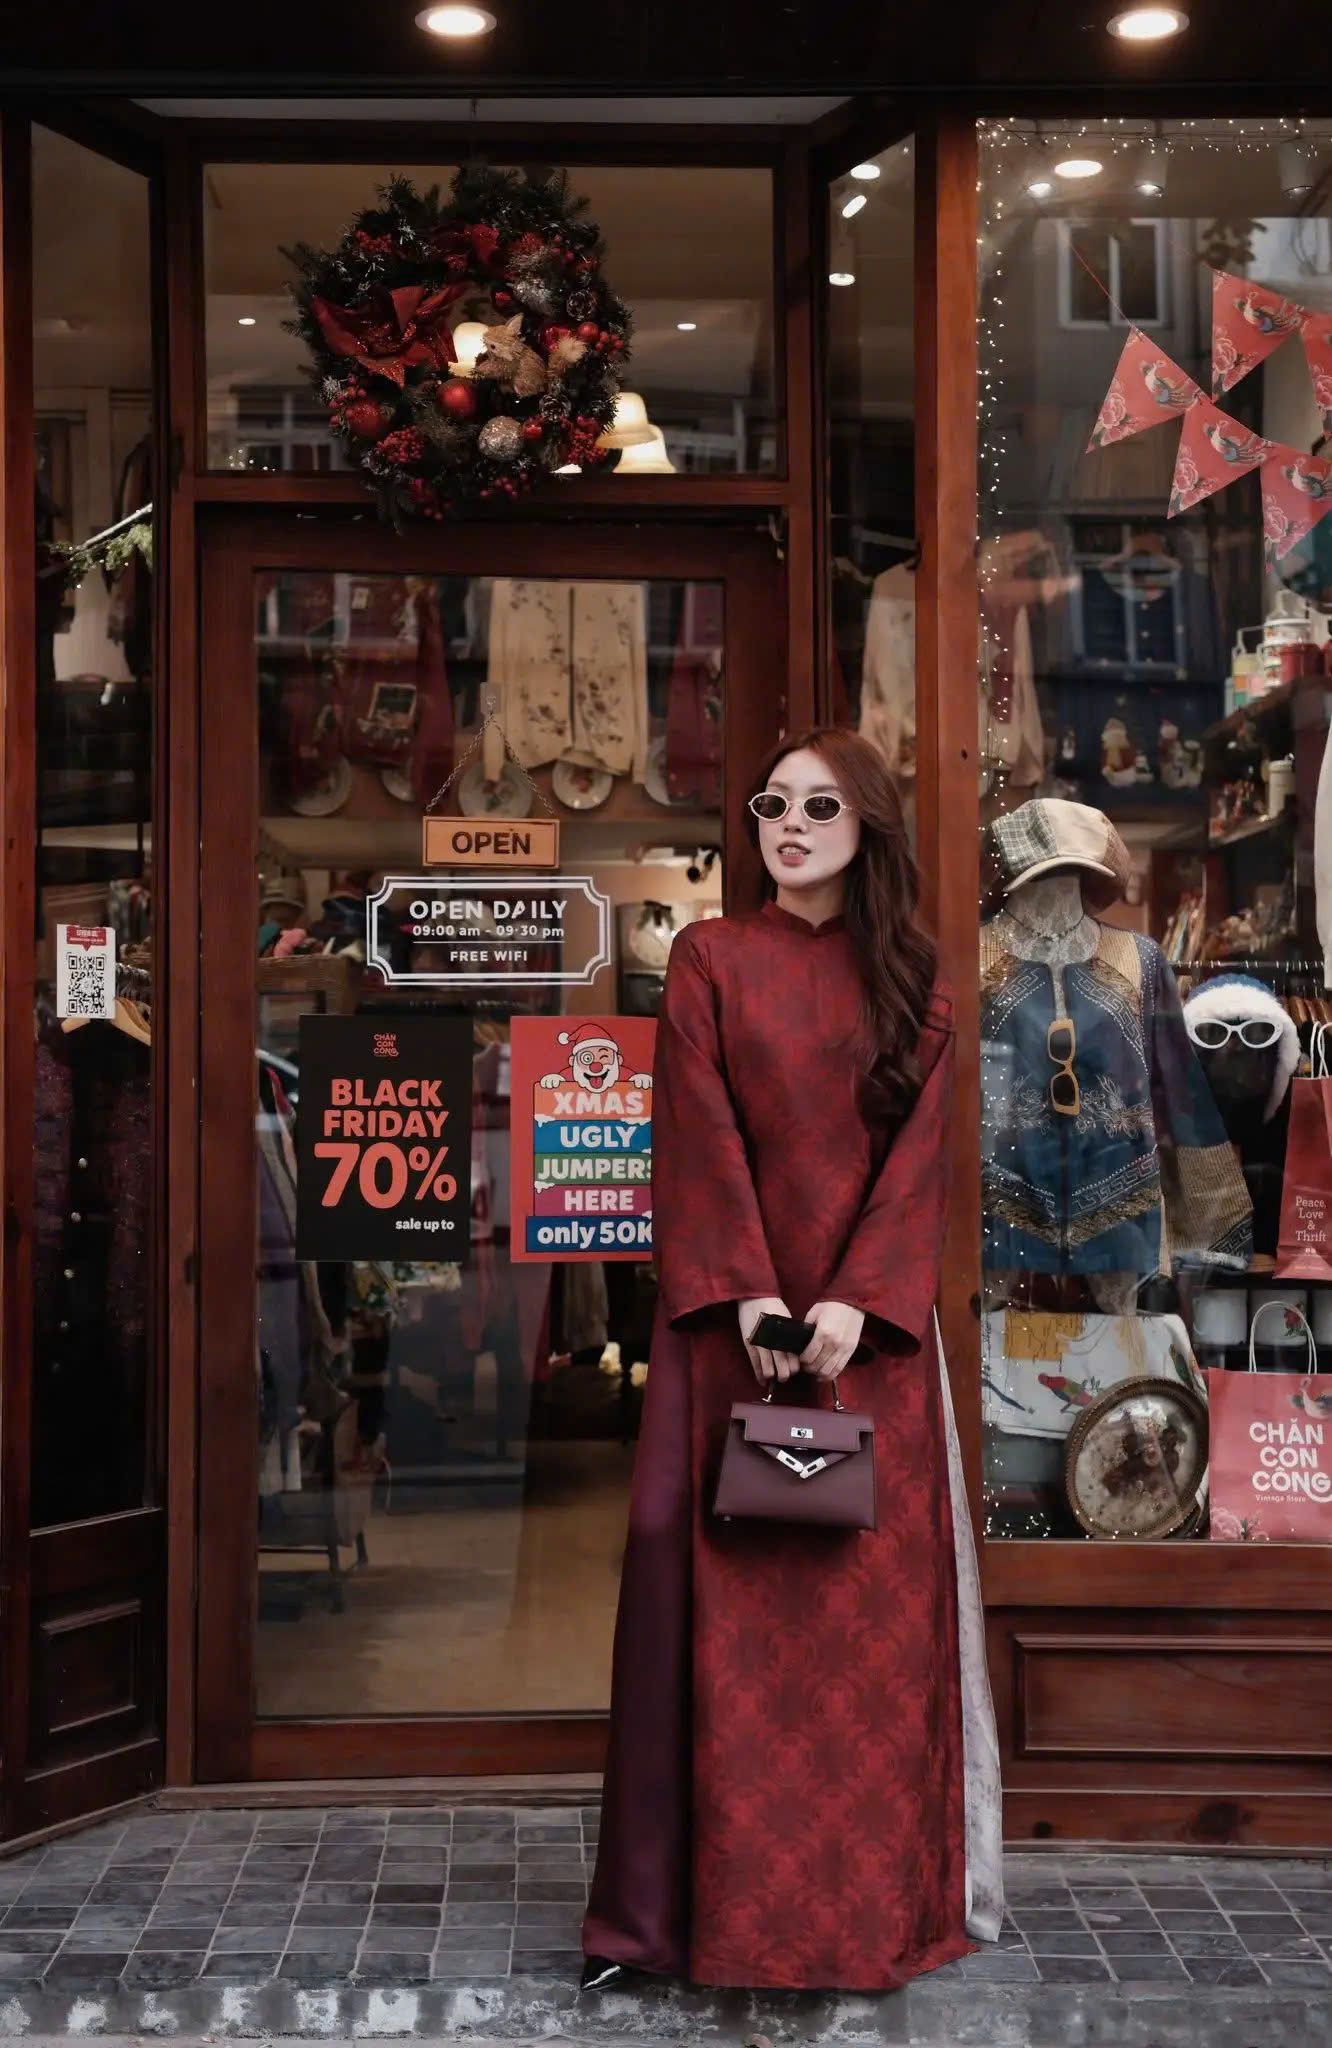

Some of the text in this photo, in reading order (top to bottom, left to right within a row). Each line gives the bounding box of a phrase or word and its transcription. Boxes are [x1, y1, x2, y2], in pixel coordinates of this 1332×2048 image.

[451, 831, 531, 855] OPEN
[409, 900, 568, 920] OPEN DAILY
[412, 924, 454, 936] 09:00
[459, 927, 480, 936] am
[542, 927, 565, 939] pm
[450, 951, 528, 962] FREE WIFI
[331, 1078, 443, 1107] BLACK
[553, 1091, 644, 1115] XMAS
[323, 1109, 449, 1138] FRIDAY
[560, 1126, 637, 1148] UGLY
[314, 1142, 457, 1209] 70%
[537, 1158, 651, 1180] JUMPER
[564, 1189, 634, 1212] HERE
[1295, 1195, 1327, 1208] Peace,
[1298, 1207, 1324, 1219] Love
[395, 1217, 455, 1232] sale up to
[537, 1221, 596, 1249] only
[1307, 1219, 1315, 1230] &
[1295, 1230, 1327, 1242] Thrift
[1249, 1417, 1324, 1445] CHĂN
[1260, 1446, 1318, 1468] CON
[1252, 1466, 1332, 1503] CÔNG
